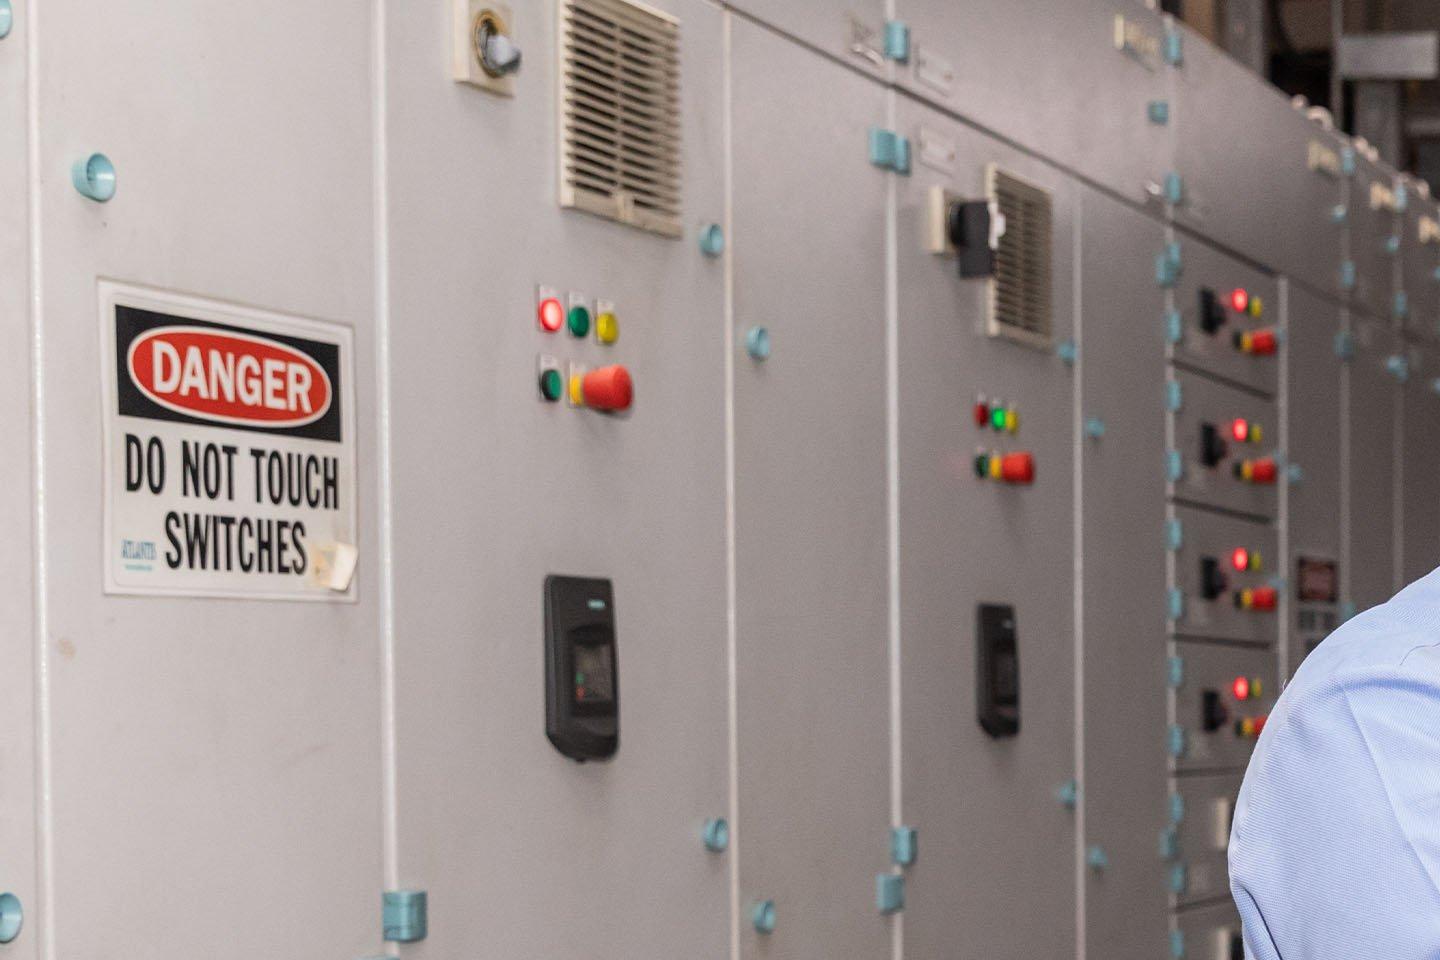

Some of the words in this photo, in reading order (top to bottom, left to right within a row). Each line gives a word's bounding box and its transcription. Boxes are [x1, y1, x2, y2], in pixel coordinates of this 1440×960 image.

[152, 339, 313, 414] DANGER
[126, 433, 166, 494] DO
[182, 440, 238, 501] NOT
[250, 449, 340, 510] TOUCH
[165, 511, 306, 575] SWITCHES
